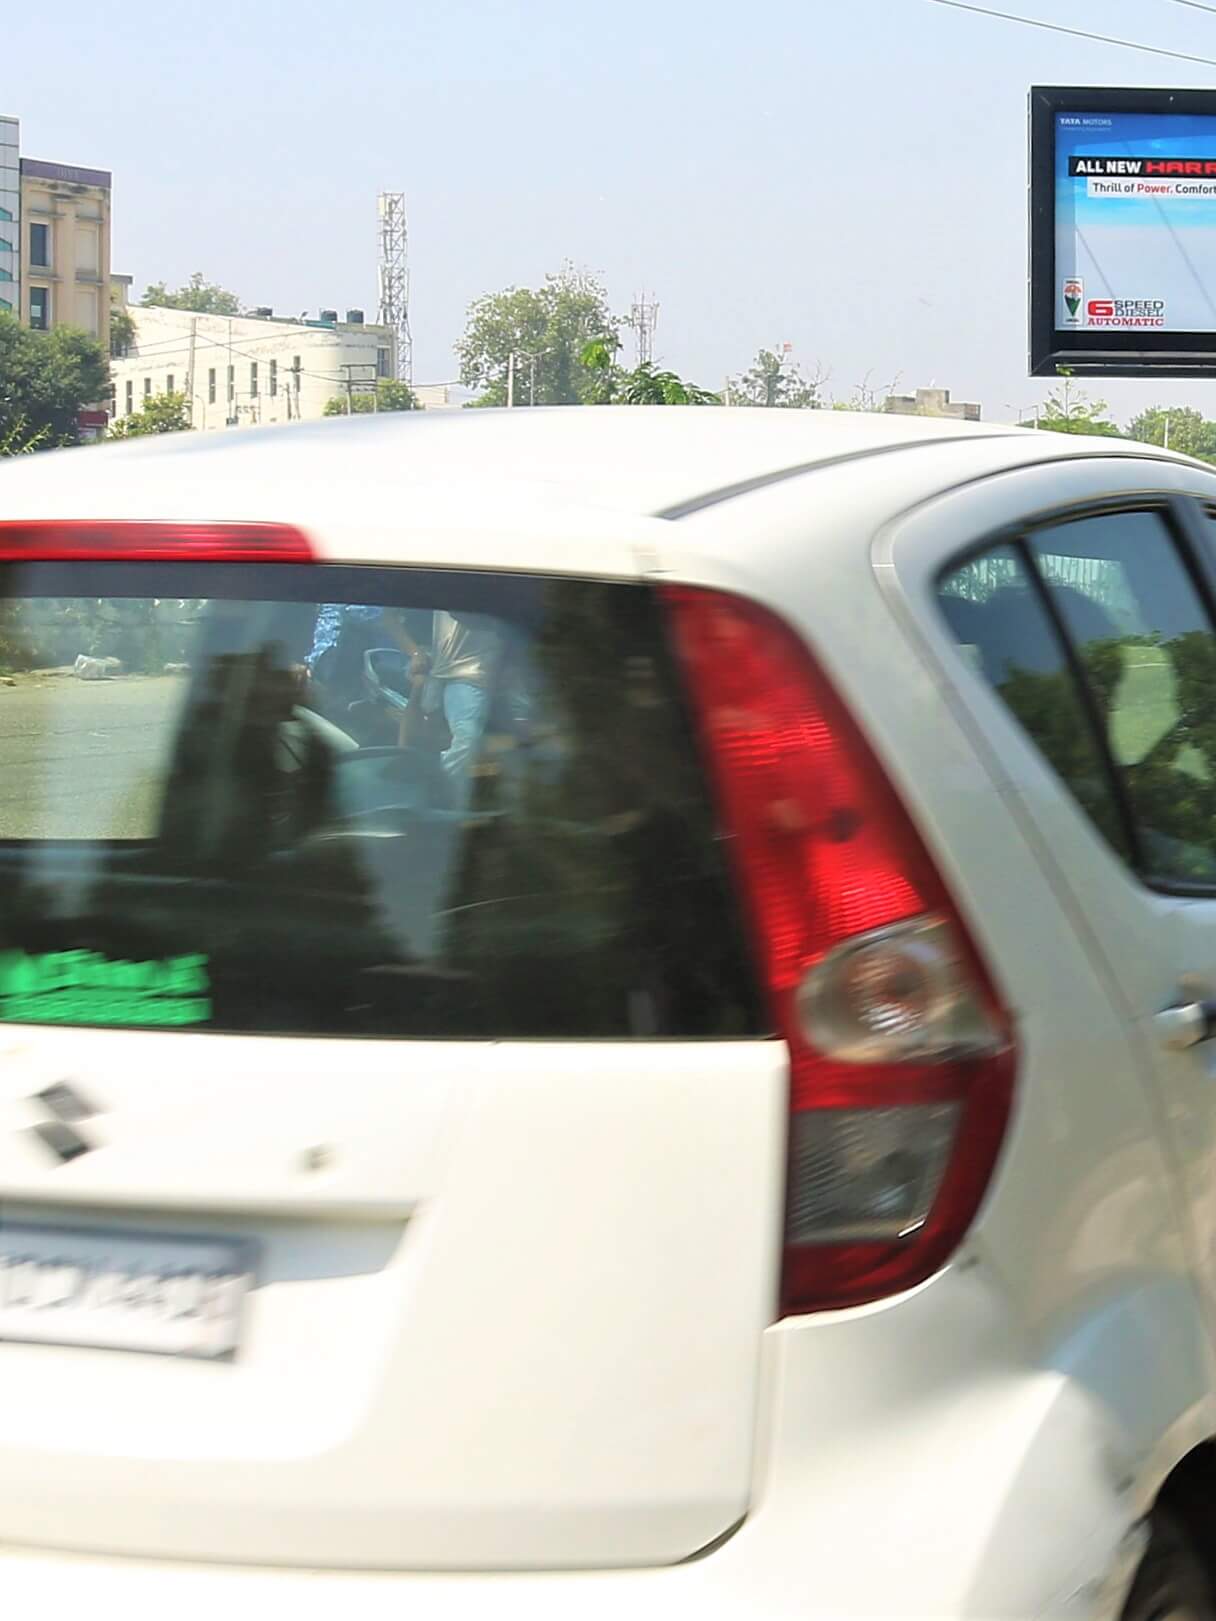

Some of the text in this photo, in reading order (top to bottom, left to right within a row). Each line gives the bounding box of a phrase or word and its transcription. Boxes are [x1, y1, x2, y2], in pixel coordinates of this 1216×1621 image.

[1060, 118, 1081, 126] TATA
[1076, 160, 1104, 173] ALL
[1106, 161, 1142, 173] NEW
[1093, 182, 1122, 193] Thrill
[1125, 182, 1135, 193] of
[1137, 183, 1173, 194] Power.
[1175, 183, 1216, 194] Comfort
[1087, 300, 1164, 317] 6 SPEED
[1114, 308, 1164, 317] DIESEL
[1087, 317, 1164, 326] AUTOMATIC
